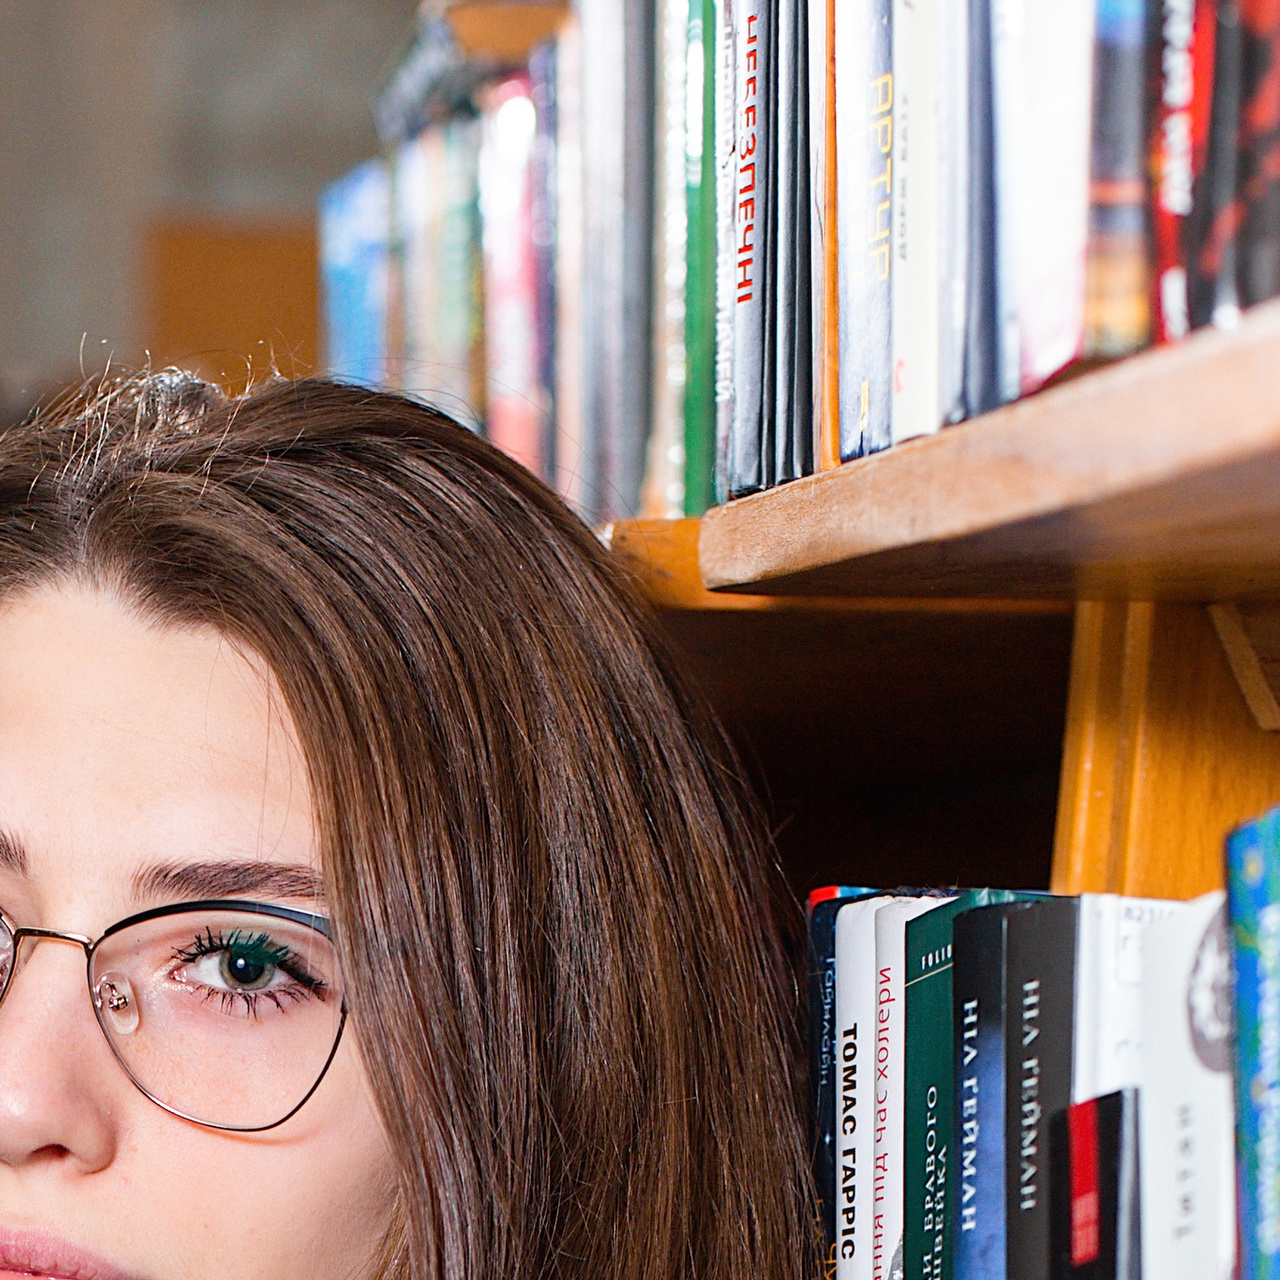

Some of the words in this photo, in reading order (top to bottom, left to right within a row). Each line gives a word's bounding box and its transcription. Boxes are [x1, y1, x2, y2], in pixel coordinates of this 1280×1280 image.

[869, 71, 893, 281] АРТУР
[921, 943, 953, 971] FOLIO
[877, 967, 896, 1080] холери
[962, 998, 979, 1067] НІЛ
[1022, 979, 1040, 1047] НІЛ
[842, 1022, 857, 1136] ТОМАС
[875, 1090, 888, 1143] час
[874, 1152, 889, 1202] під
[924, 1085, 938, 1232] БРАВОГО
[841, 1148, 857, 1260] ГАРРІС
